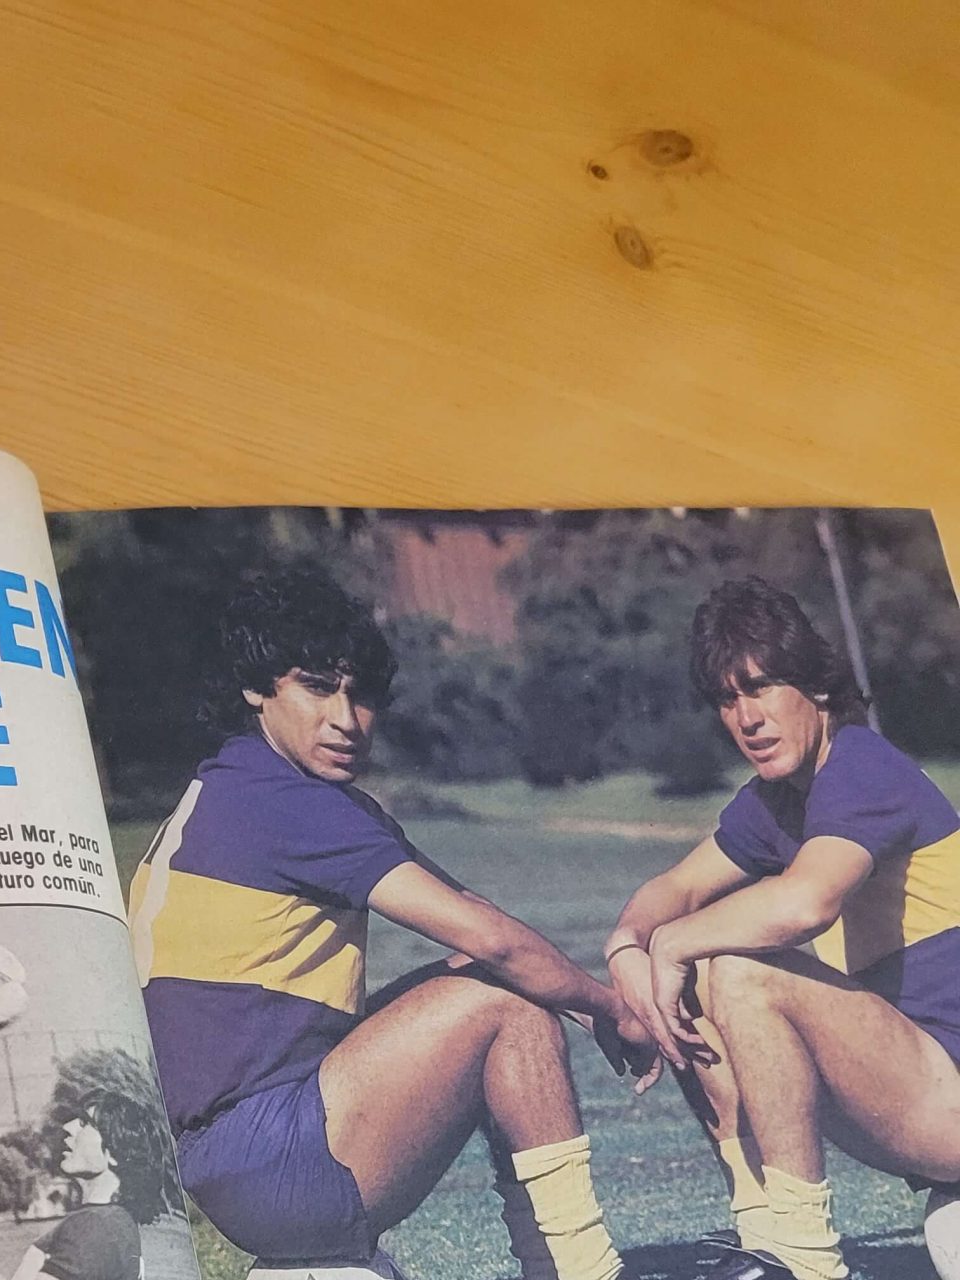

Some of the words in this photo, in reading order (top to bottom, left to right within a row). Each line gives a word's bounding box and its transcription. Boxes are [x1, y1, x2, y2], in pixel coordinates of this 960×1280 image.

[20, 824, 63, 847] Mar,
[68, 832, 100, 854] para
[52, 849, 74, 869] de
[78, 857, 104, 877] una
[42, 875, 100, 898] común.
